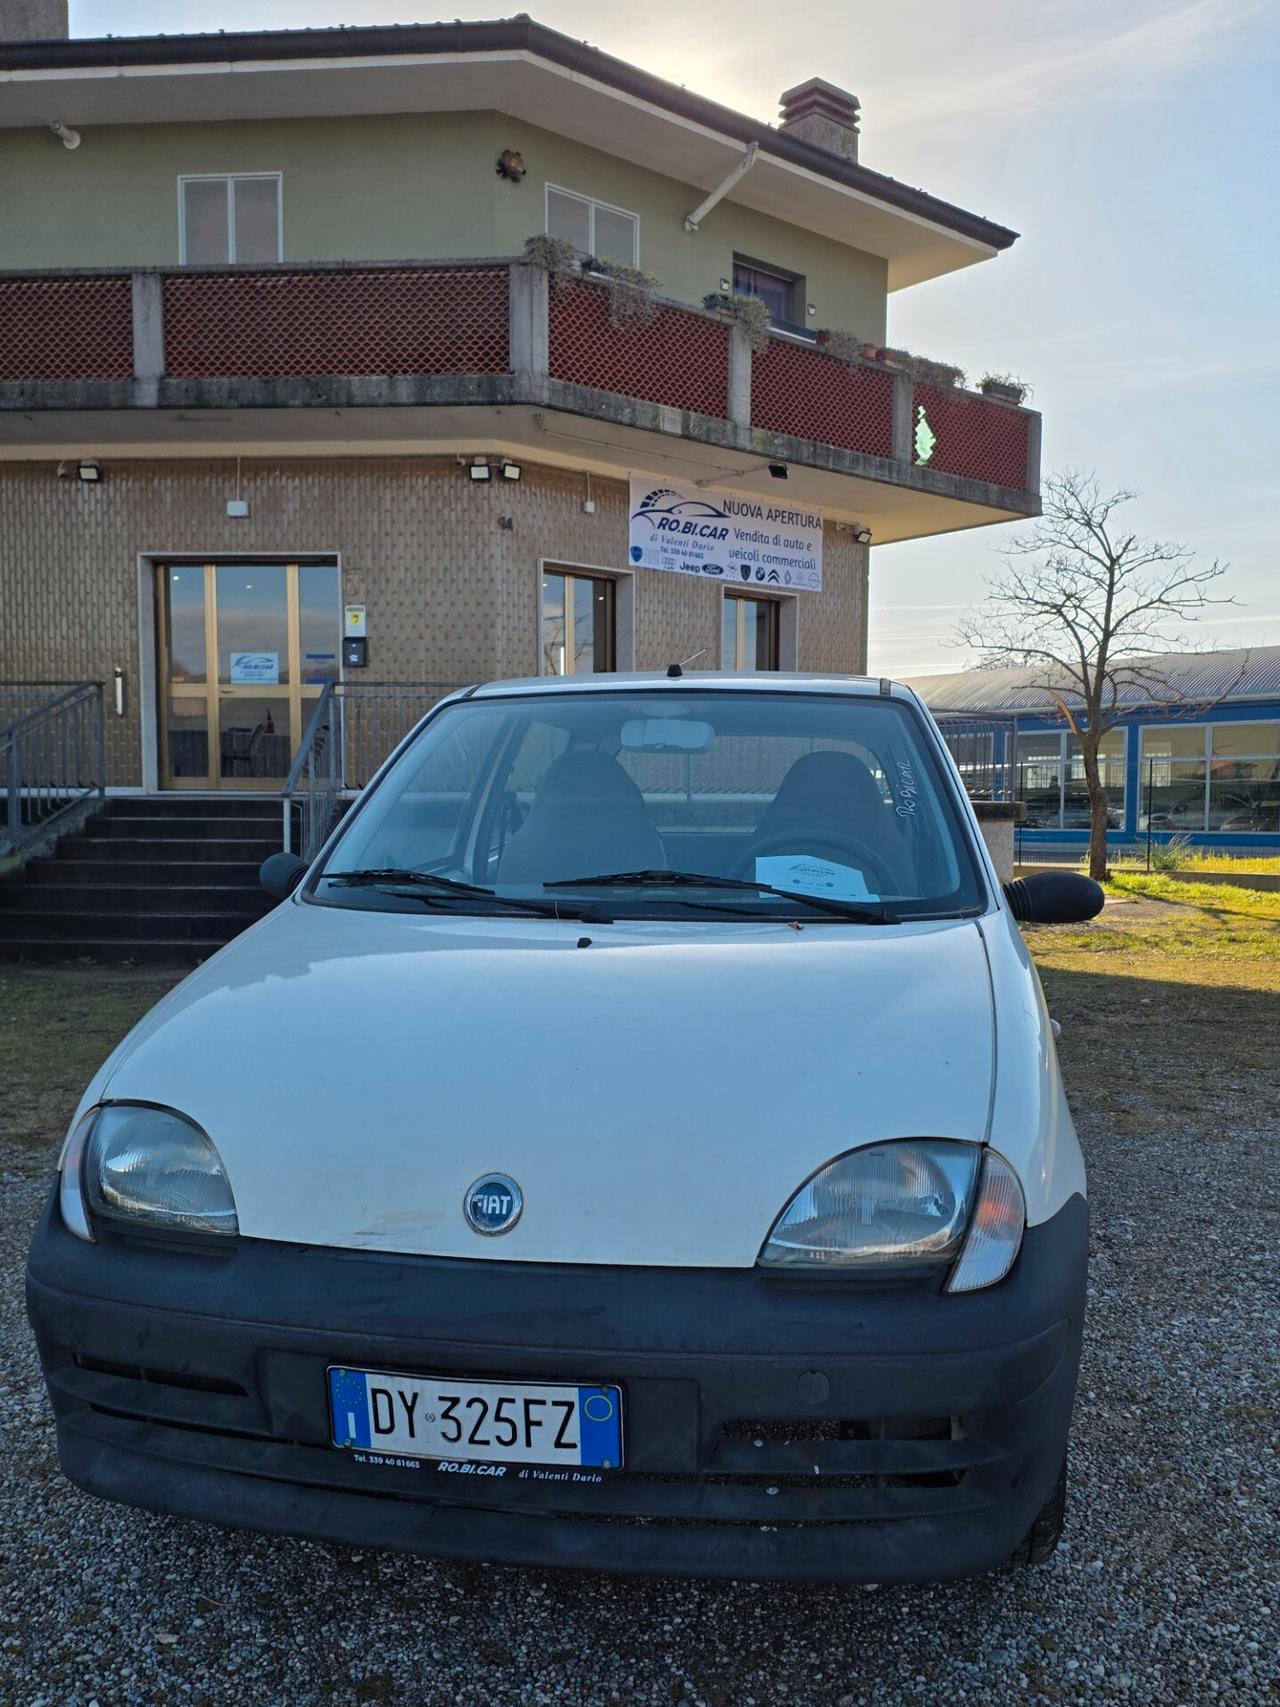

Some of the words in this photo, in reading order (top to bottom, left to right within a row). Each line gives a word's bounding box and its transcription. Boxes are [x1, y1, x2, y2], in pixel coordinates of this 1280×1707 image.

[723, 500, 763, 520] NUOVA
[766, 508, 822, 529] APERTURA
[657, 517, 729, 541] RO.BI.CAR
[734, 527, 770, 545] Vendita
[772, 534, 781, 547] di
[783, 538, 804, 551] auto
[806, 542, 813, 551] e
[650, 533, 658, 542] di
[661, 534, 690, 548] Valenti
[691, 540, 715, 552] Dario
[679, 561, 701, 574] Jeep
[729, 547, 760, 562] veicoli
[762, 554, 816, 571] commerciali
[473, 1194, 511, 1215] FIAT
[370, 1388, 419, 1438] DY
[437, 1395, 578, 1449] 325FZ
[353, 1454, 368, 1463] Tel.
[369, 1455, 383, 1465] 339
[385, 1457, 395, 1466] 40
[437, 1461, 507, 1477] RO.BI.CAR
[518, 1469, 528, 1479] di
[533, 1470, 568, 1481] Valenti
[572, 1472, 602, 1483] Dario
